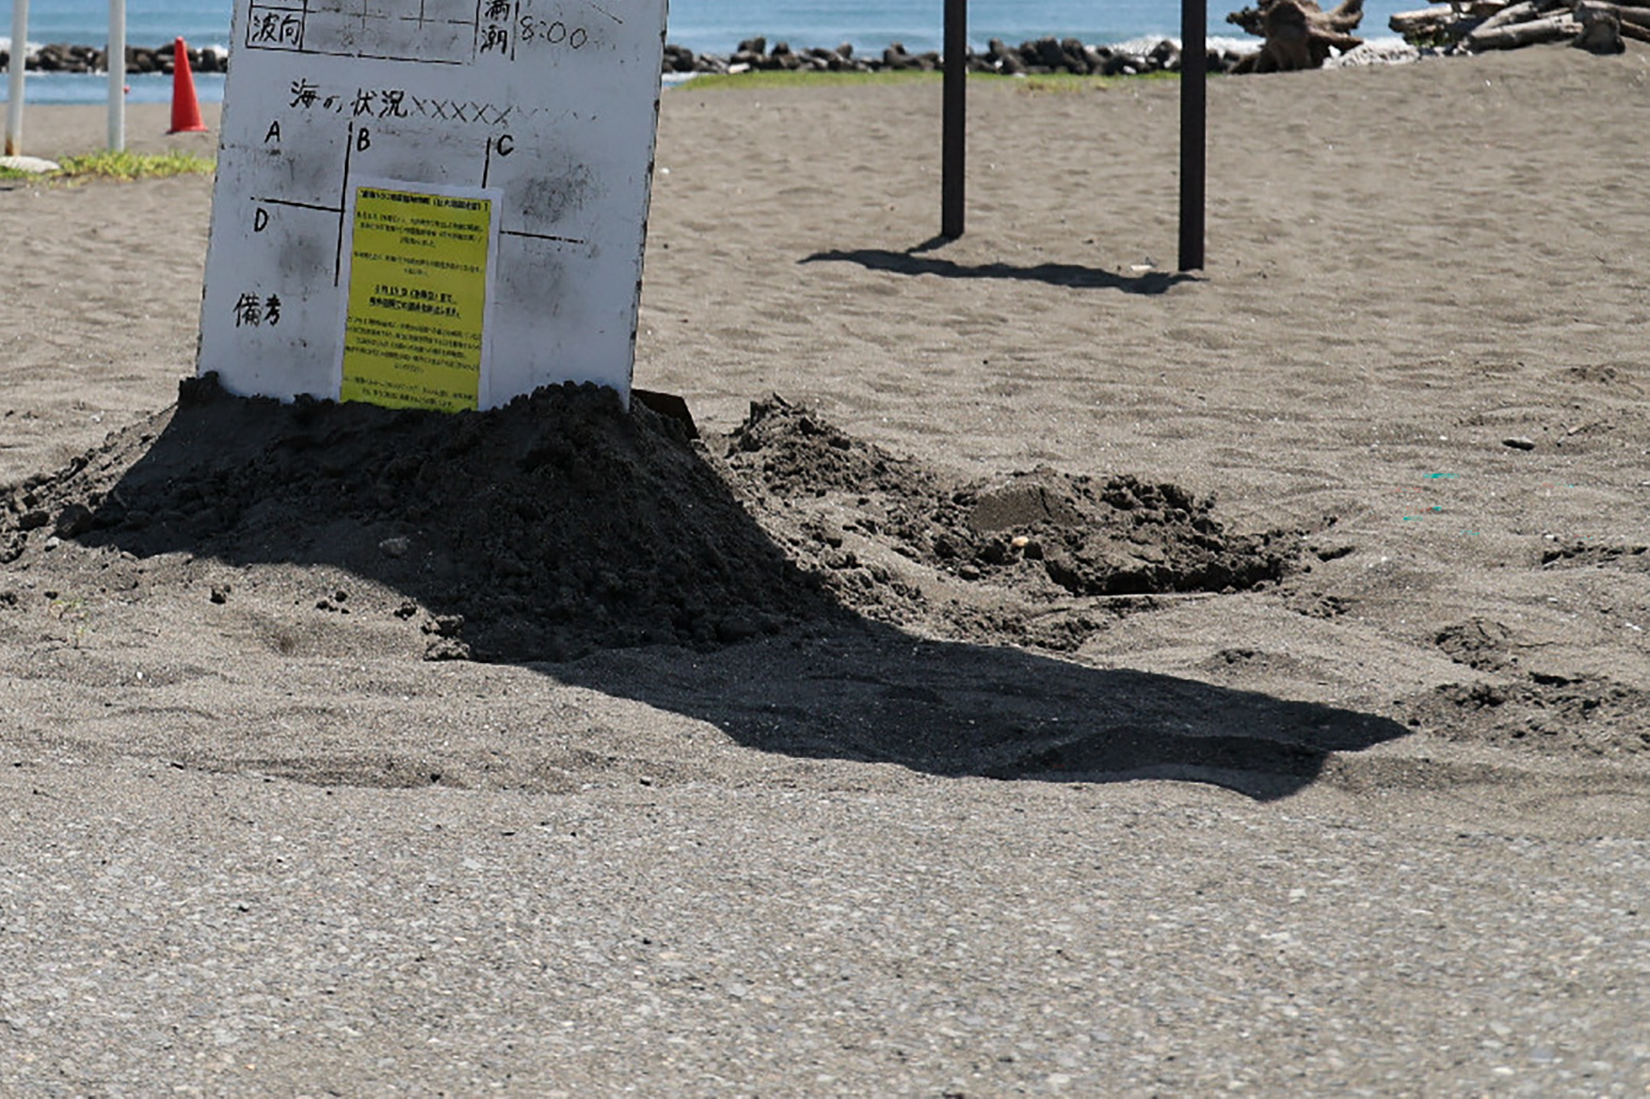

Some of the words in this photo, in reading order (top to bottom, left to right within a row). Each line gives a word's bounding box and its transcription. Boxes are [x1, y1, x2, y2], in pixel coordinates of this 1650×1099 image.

[252, 12, 301, 44] 波向
[264, 120, 281, 143] A
[357, 128, 371, 151] B
[497, 134, 515, 156] C
[254, 207, 269, 232] D
[233, 293, 282, 328] 備考
